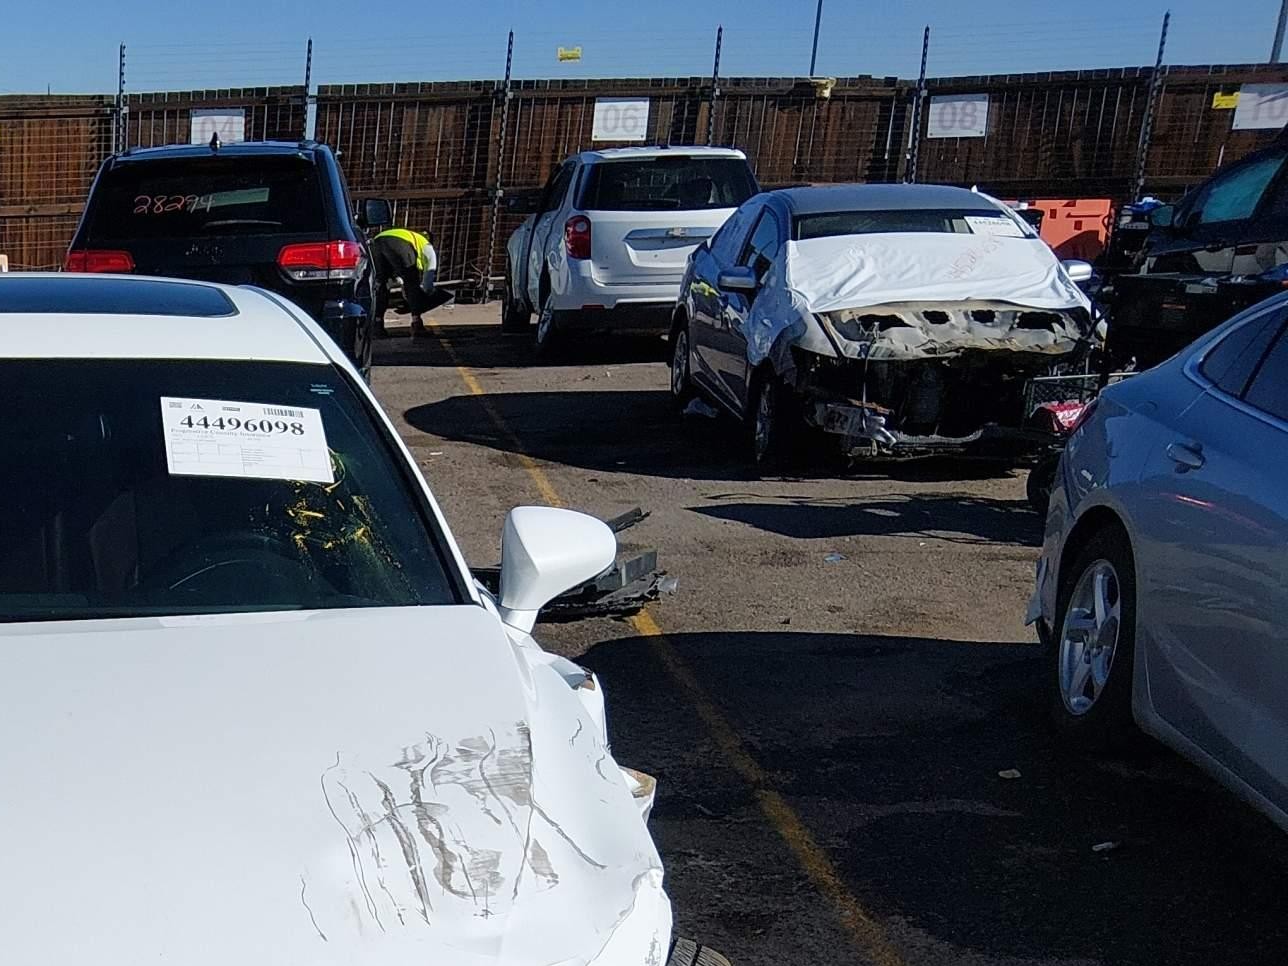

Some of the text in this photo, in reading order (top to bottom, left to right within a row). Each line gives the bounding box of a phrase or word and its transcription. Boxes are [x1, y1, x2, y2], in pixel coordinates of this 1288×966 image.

[601, 104, 640, 133] 06
[938, 102, 978, 131] 08
[133, 194, 213, 215] 28294
[179, 415, 305, 436] 44496098
